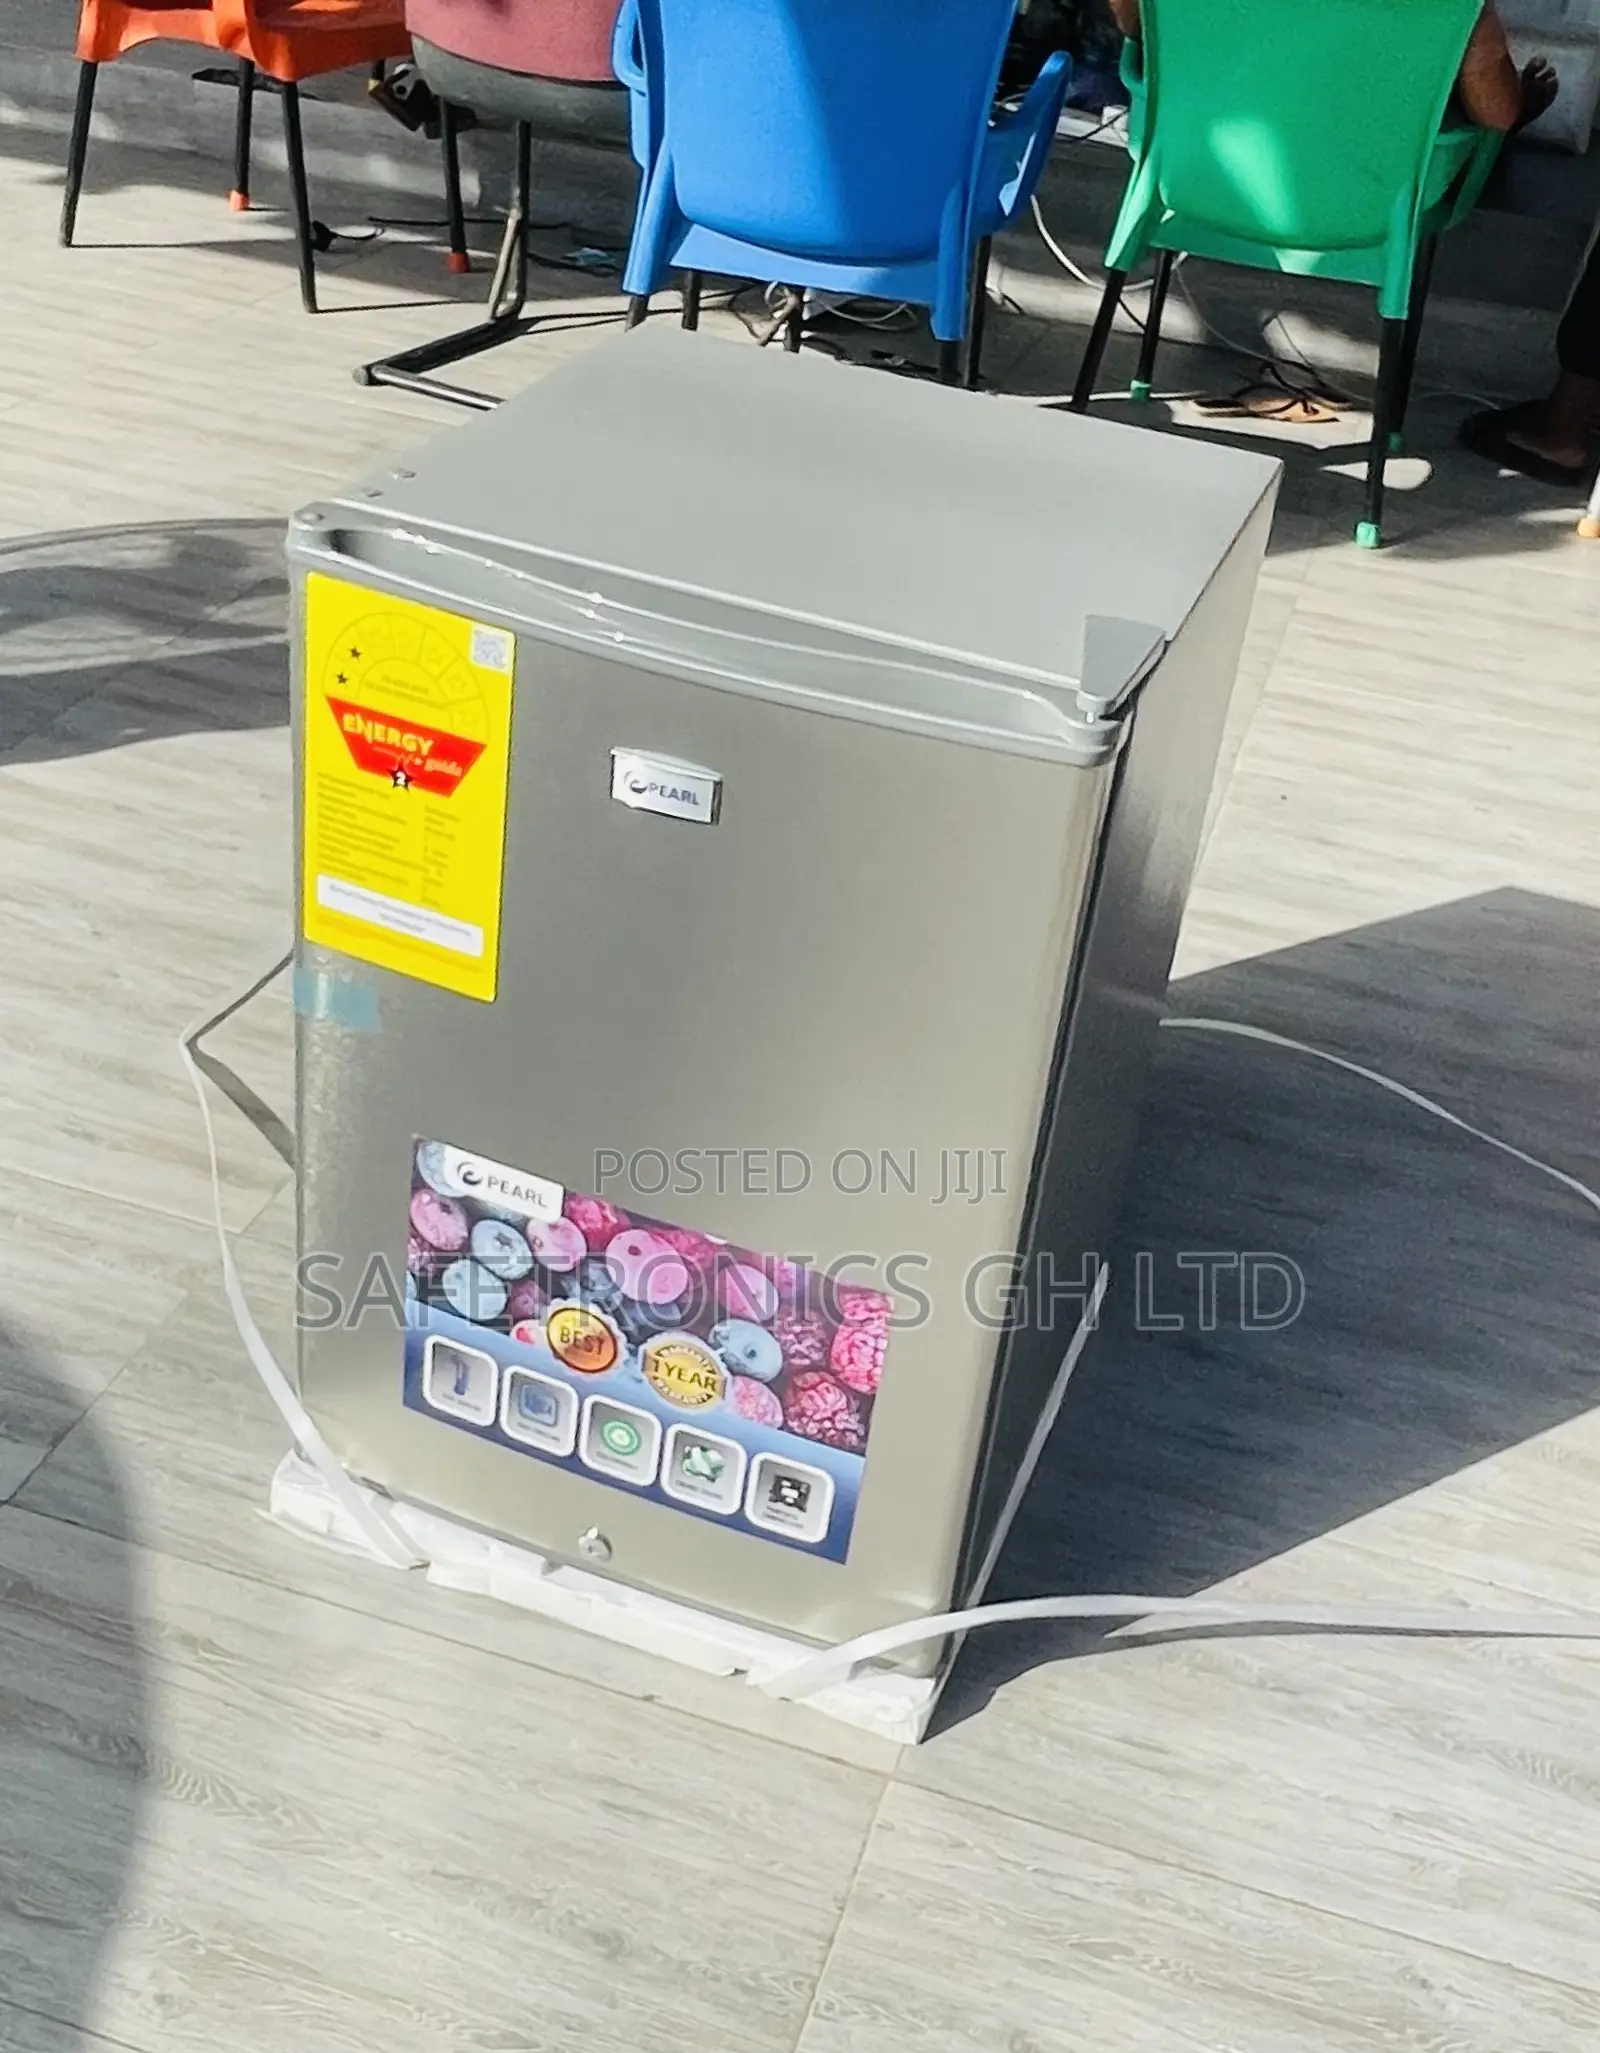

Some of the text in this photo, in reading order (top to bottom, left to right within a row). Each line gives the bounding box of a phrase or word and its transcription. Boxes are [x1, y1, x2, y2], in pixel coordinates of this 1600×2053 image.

[343, 712, 433, 756] ENERGY
[395, 770, 407, 785] 2
[649, 782, 699, 805] PEARL
[487, 1176, 547, 1208] PEARL
[560, 1325, 605, 1355] BEST
[664, 1362, 717, 1391] YEAR
